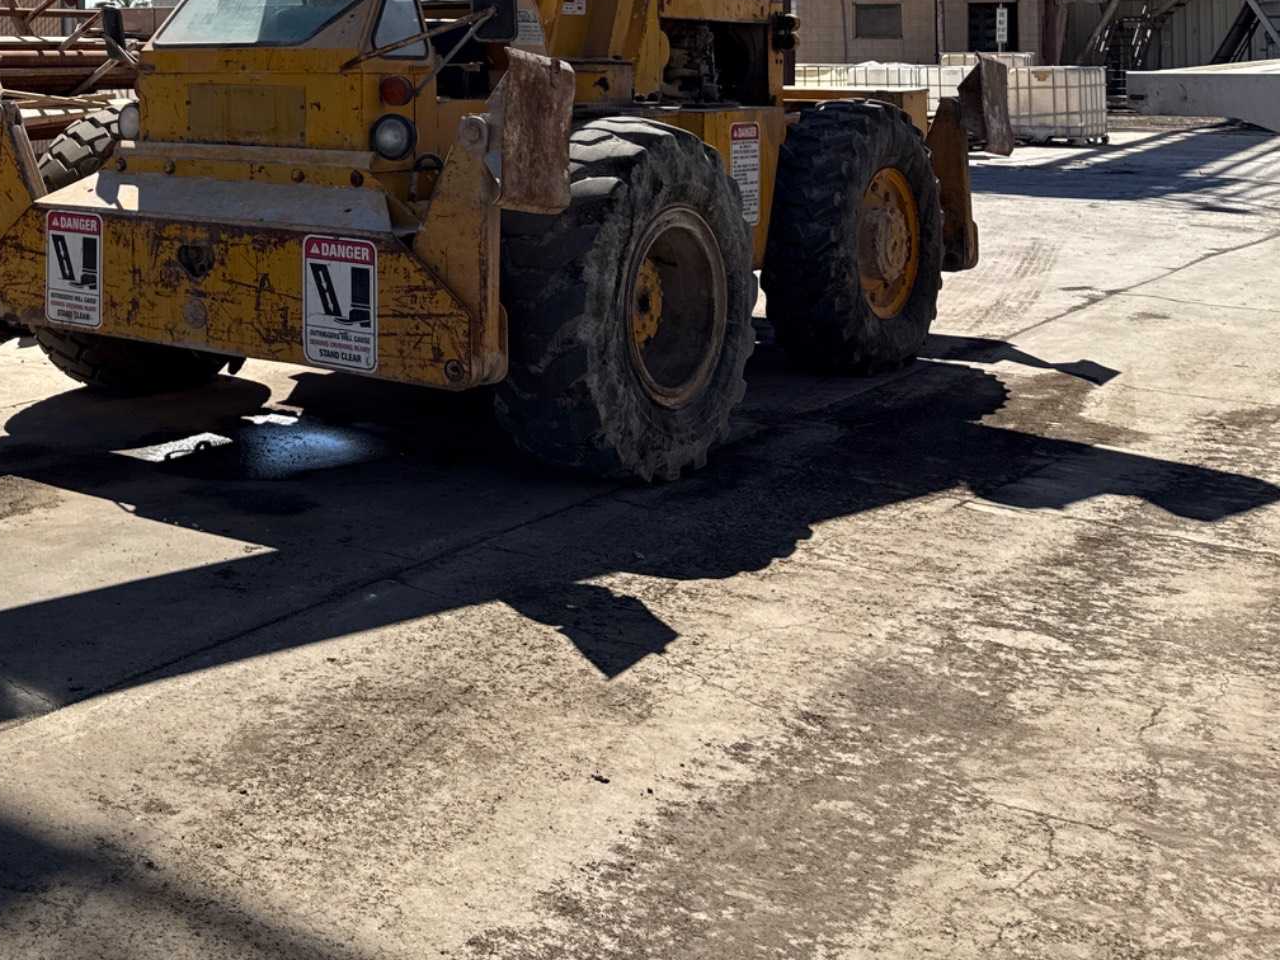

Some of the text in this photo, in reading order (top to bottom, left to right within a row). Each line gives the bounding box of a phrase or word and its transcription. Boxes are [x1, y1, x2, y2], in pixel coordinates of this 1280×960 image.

[60, 217, 97, 232] DANGER
[321, 243, 369, 260] DANGER
[319, 349, 362, 362] STAND CLEAR
